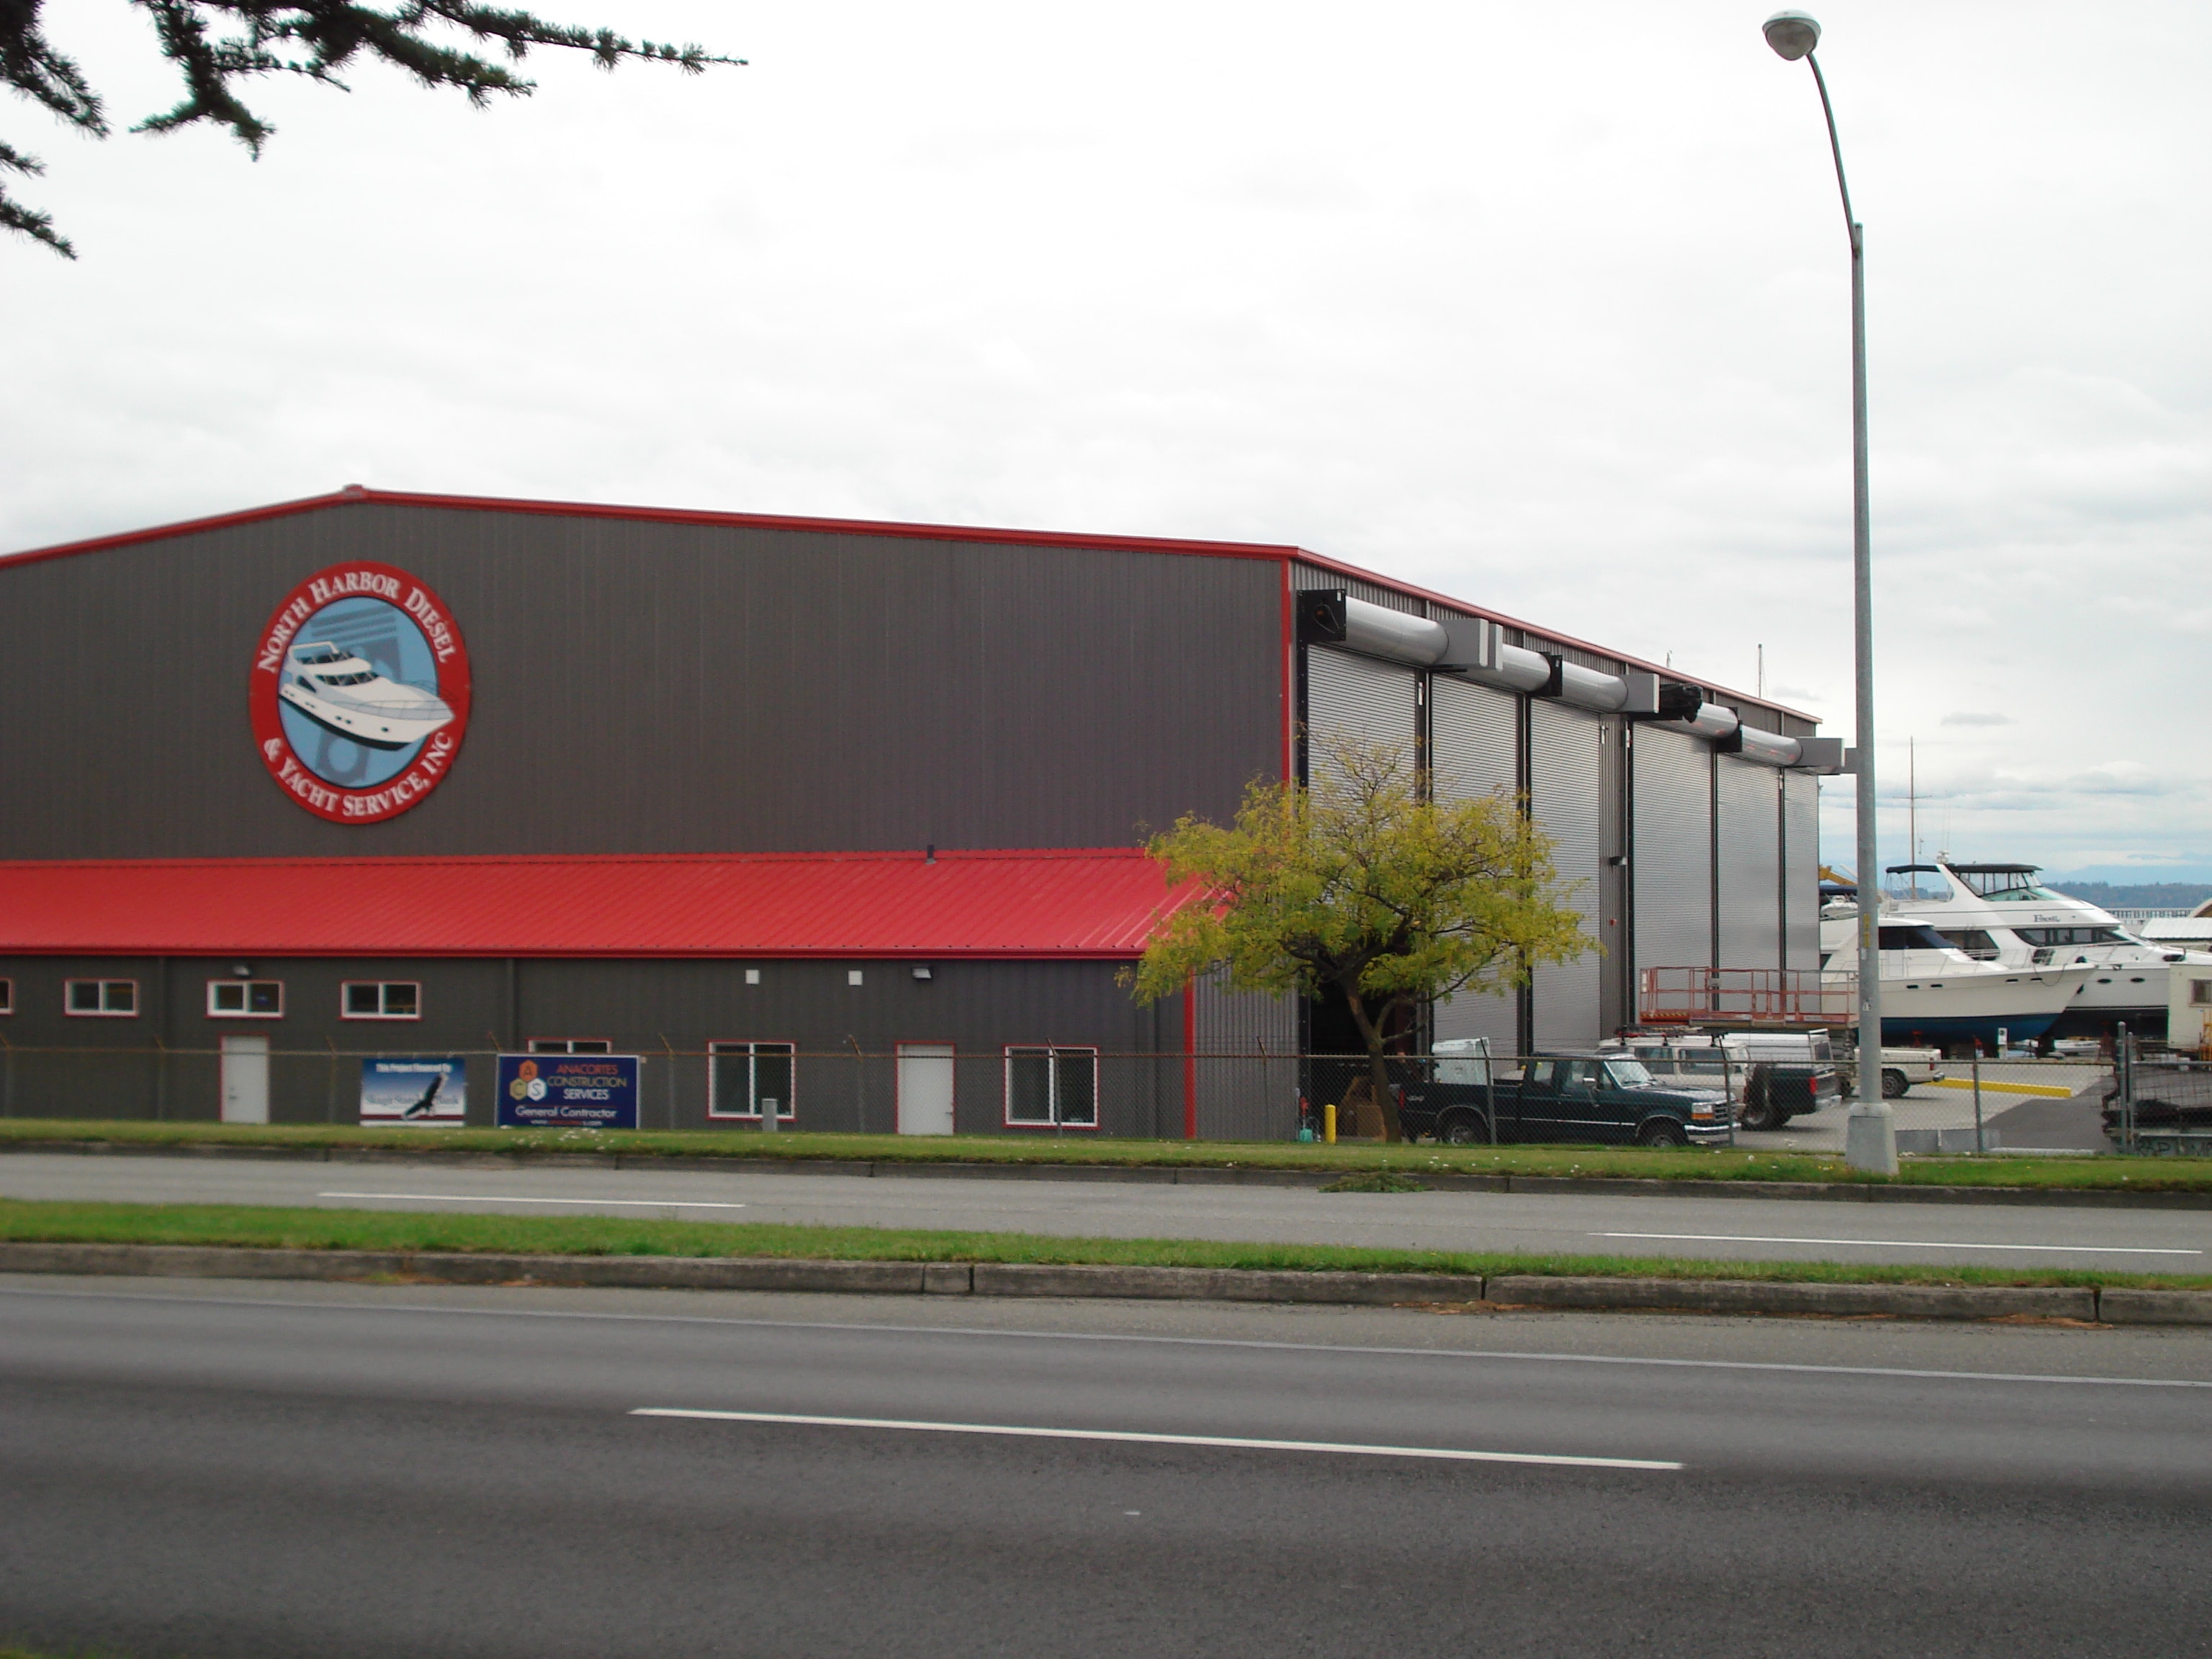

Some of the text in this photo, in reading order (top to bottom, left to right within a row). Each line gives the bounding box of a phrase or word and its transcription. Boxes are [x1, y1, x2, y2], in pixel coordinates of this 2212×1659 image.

[264, 737, 283, 762] &
[277, 757, 339, 812] YACHT
[421, 732, 453, 775] INC
[523, 1065, 533, 1076] A
[556, 1064, 619, 1075] ANACORTES
[547, 1076, 628, 1088] CONSTRUCTION
[513, 1082, 542, 1097] C S
[563, 1088, 610, 1100] SERVICES
[515, 1105, 619, 1118] General Contractor
